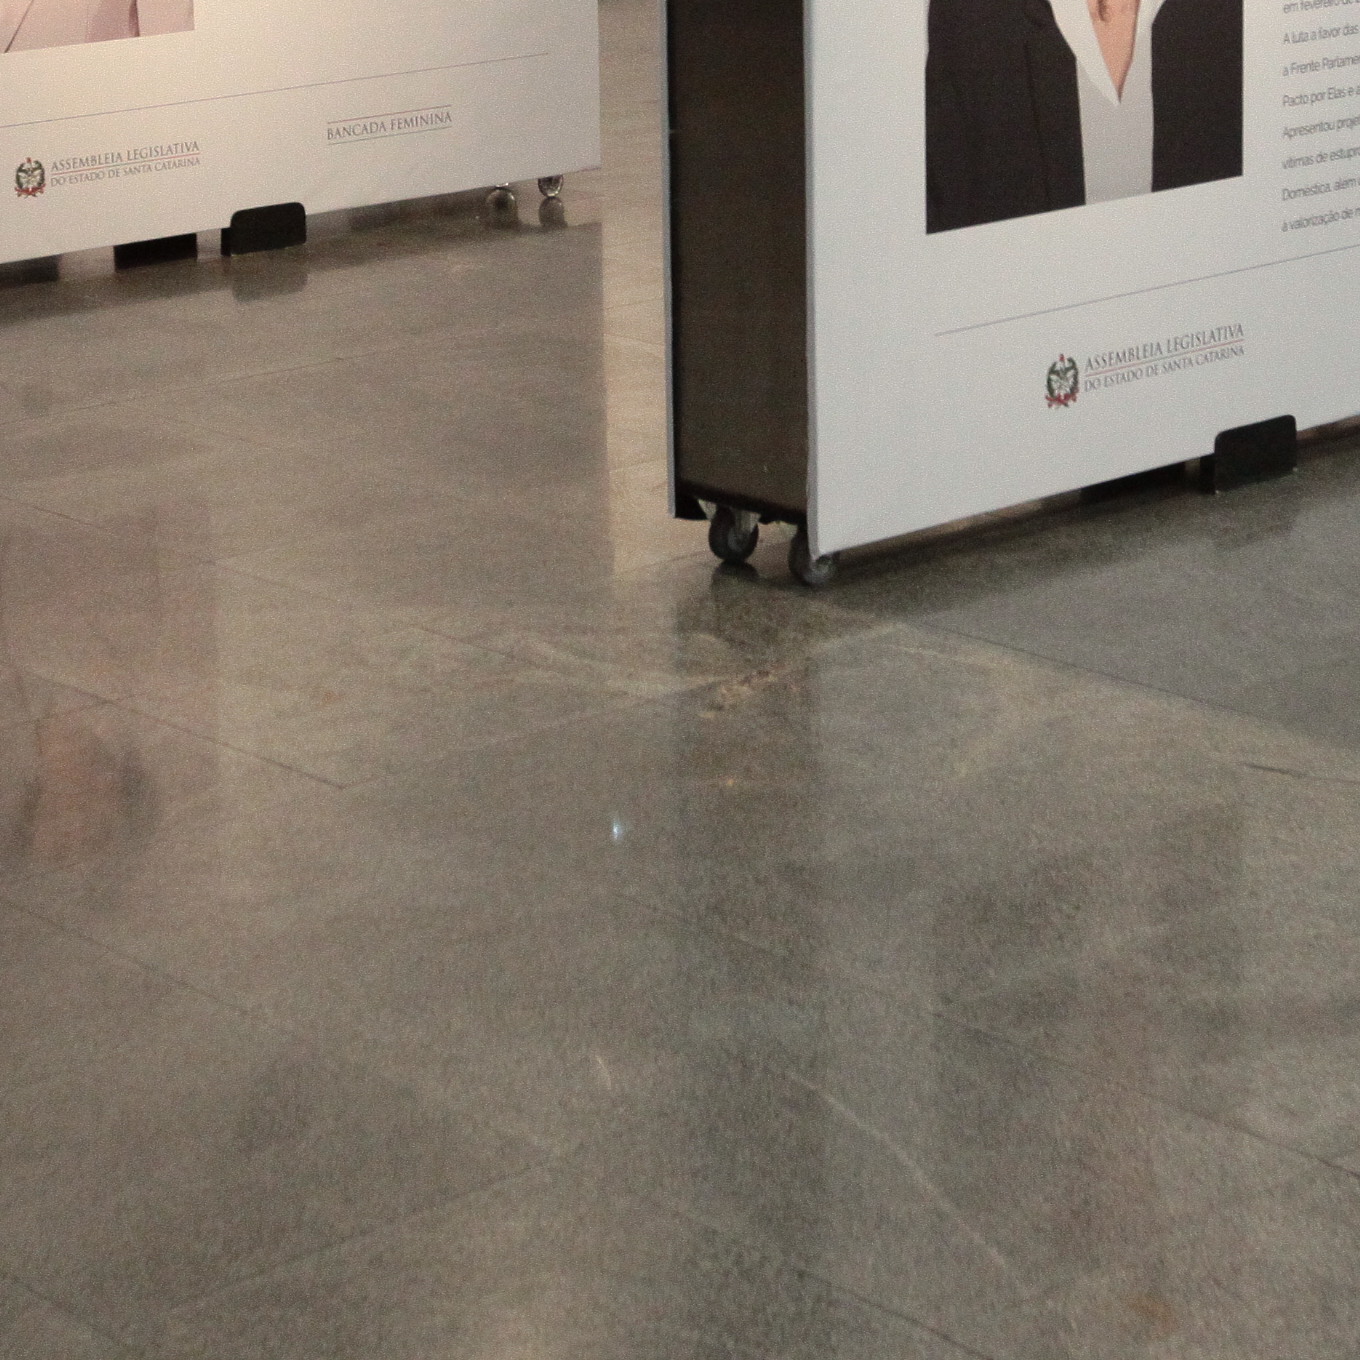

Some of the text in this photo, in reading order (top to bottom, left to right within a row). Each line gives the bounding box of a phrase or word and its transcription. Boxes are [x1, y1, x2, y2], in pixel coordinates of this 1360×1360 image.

[327, 112, 452, 140] BANCADA FEMININA
[51, 140, 200, 172] ASSEMBLEIA LEGISLATIVA
[50, 157, 201, 187] DO ESTADO DE SANTA CATARINA
[1085, 323, 1244, 372] ASSEMBLEIA LEGISLATIVA
[1104, 368, 1143, 388] ESTADO
